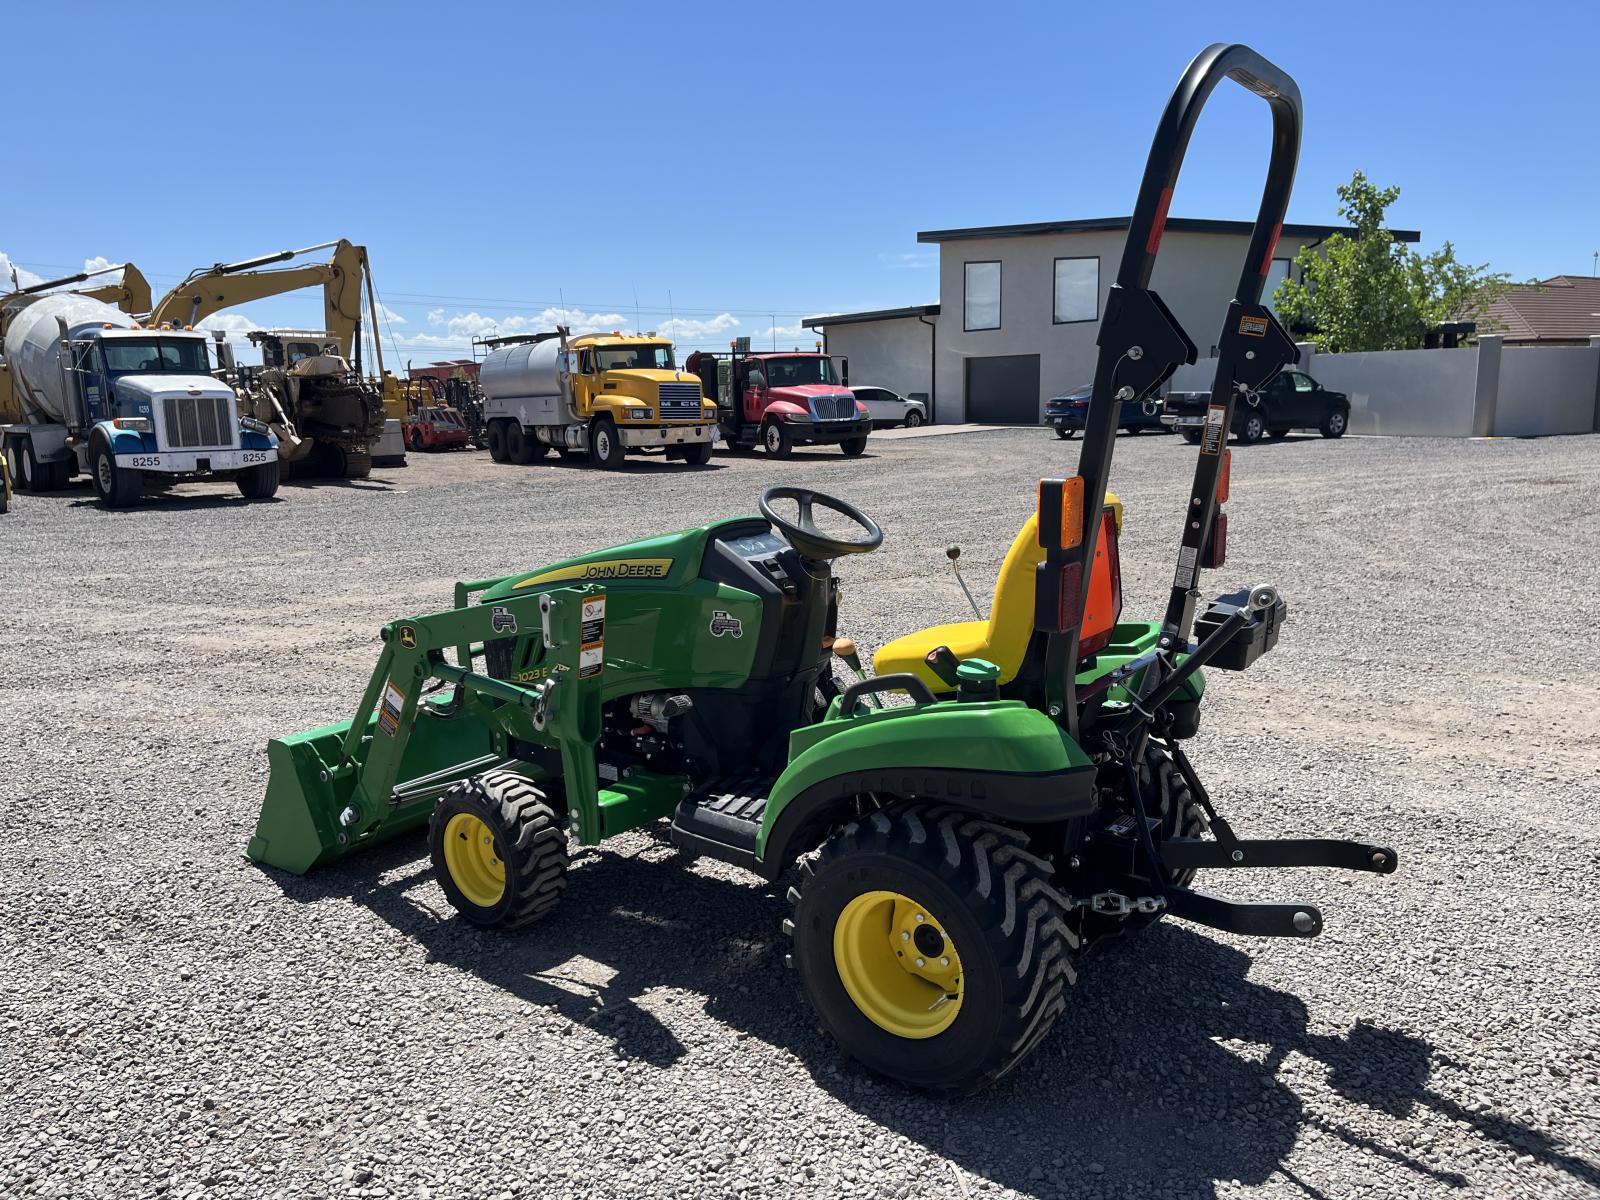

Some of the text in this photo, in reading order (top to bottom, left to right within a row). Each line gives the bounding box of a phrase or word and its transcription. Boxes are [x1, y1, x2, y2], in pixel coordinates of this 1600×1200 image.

[132, 457, 161, 467] 8255
[242, 453, 267, 463] 8255
[581, 563, 662, 578] JOHN DEERE
